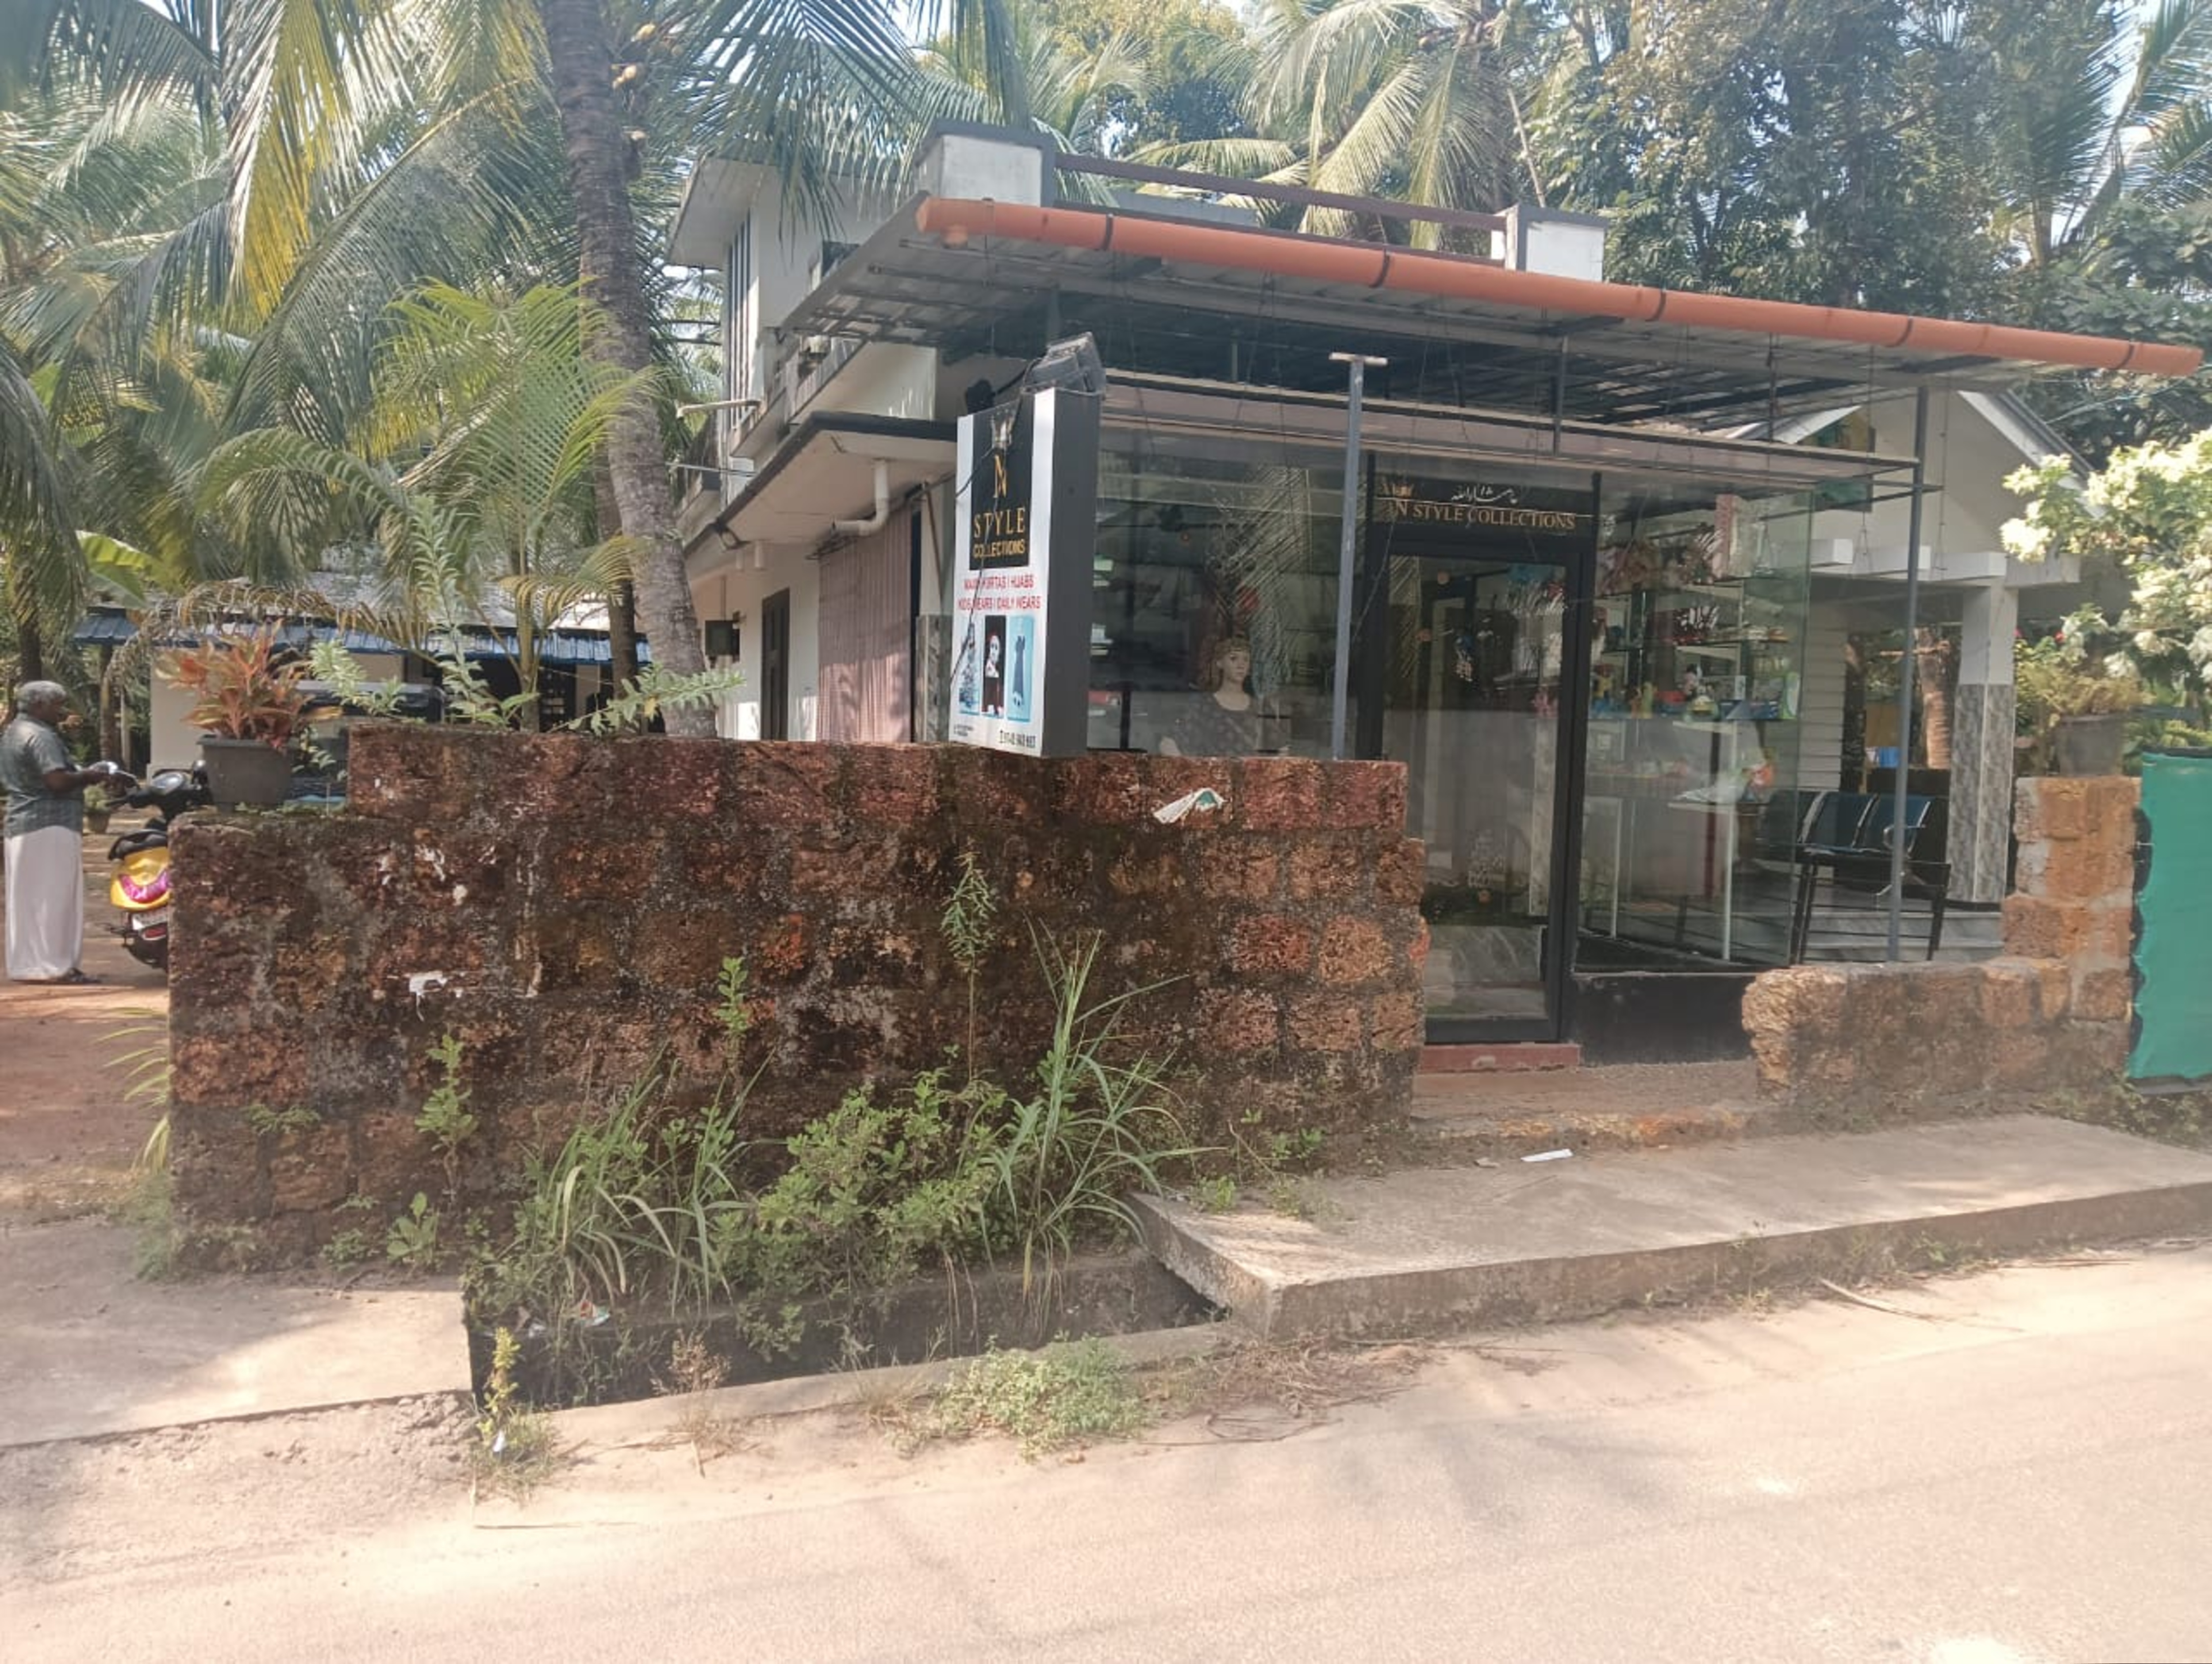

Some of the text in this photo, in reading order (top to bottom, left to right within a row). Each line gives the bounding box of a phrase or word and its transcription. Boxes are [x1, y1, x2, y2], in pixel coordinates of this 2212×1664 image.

[993, 454, 1007, 499] N
[974, 507, 1025, 538] STYLE
[1413, 503, 1465, 522] STYLE
[1468, 505, 1576, 529] COLLECTIONS
[974, 539, 1025, 559] COLLECTIONS
[1016, 596, 1041, 609] WEARS
